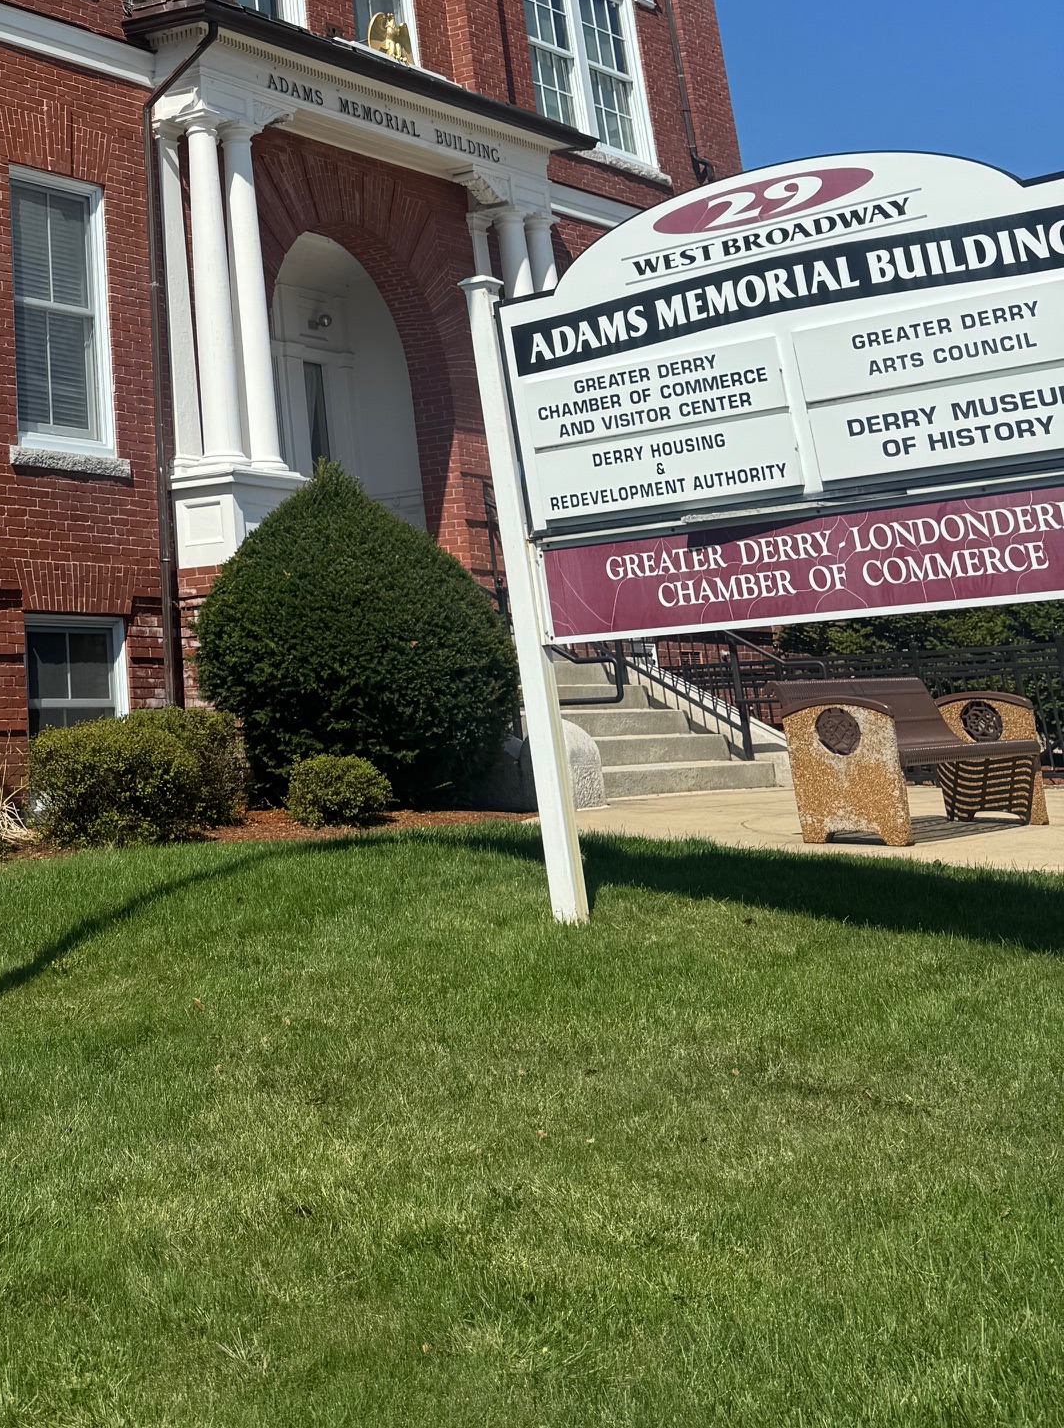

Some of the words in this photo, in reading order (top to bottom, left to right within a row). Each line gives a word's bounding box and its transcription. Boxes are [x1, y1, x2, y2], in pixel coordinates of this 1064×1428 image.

[268, 73, 324, 106] ADAMS
[338, 97, 421, 138] MEMORIAL
[434, 128, 500, 163] BUILDING
[704, 175, 823, 229] 29
[632, 243, 715, 276] WEST
[722, 197, 910, 256] BROADWAY
[530, 305, 648, 364] ADAMS
[654, 256, 860, 331] MEMORIAL
[851, 317, 952, 350] GREATER
[960, 301, 1038, 330] DERRY
[573, 367, 650, 394] GREATER
[657, 354, 717, 380] DERRY
[869, 352, 924, 376] ARTS
[933, 332, 1038, 364] COUNCIL
[537, 393, 622, 421] CHAMBER
[629, 387, 651, 405] OF
[659, 366, 768, 400] COMMERCE
[559, 419, 595, 439] AND
[601, 405, 671, 430] VISITOR
[679, 391, 752, 417] CENTER
[846, 406, 937, 437] DERRY
[951, 385, 1064, 421] MUSEU
[592, 445, 643, 468] DERRY
[650, 432, 726, 458] HOUSING
[882, 437, 917, 458] OF
[927, 415, 1054, 452] HISTORY
[550, 478, 686, 512] REDEVELOPMENT
[693, 462, 787, 491] AUTHORITY
[656, 462, 666, 475] &
[605, 545, 727, 581] GREATER
[658, 569, 798, 608] CHAMBER
[808, 563, 847, 592] OF
[862, 541, 1049, 587] COMMERCE
